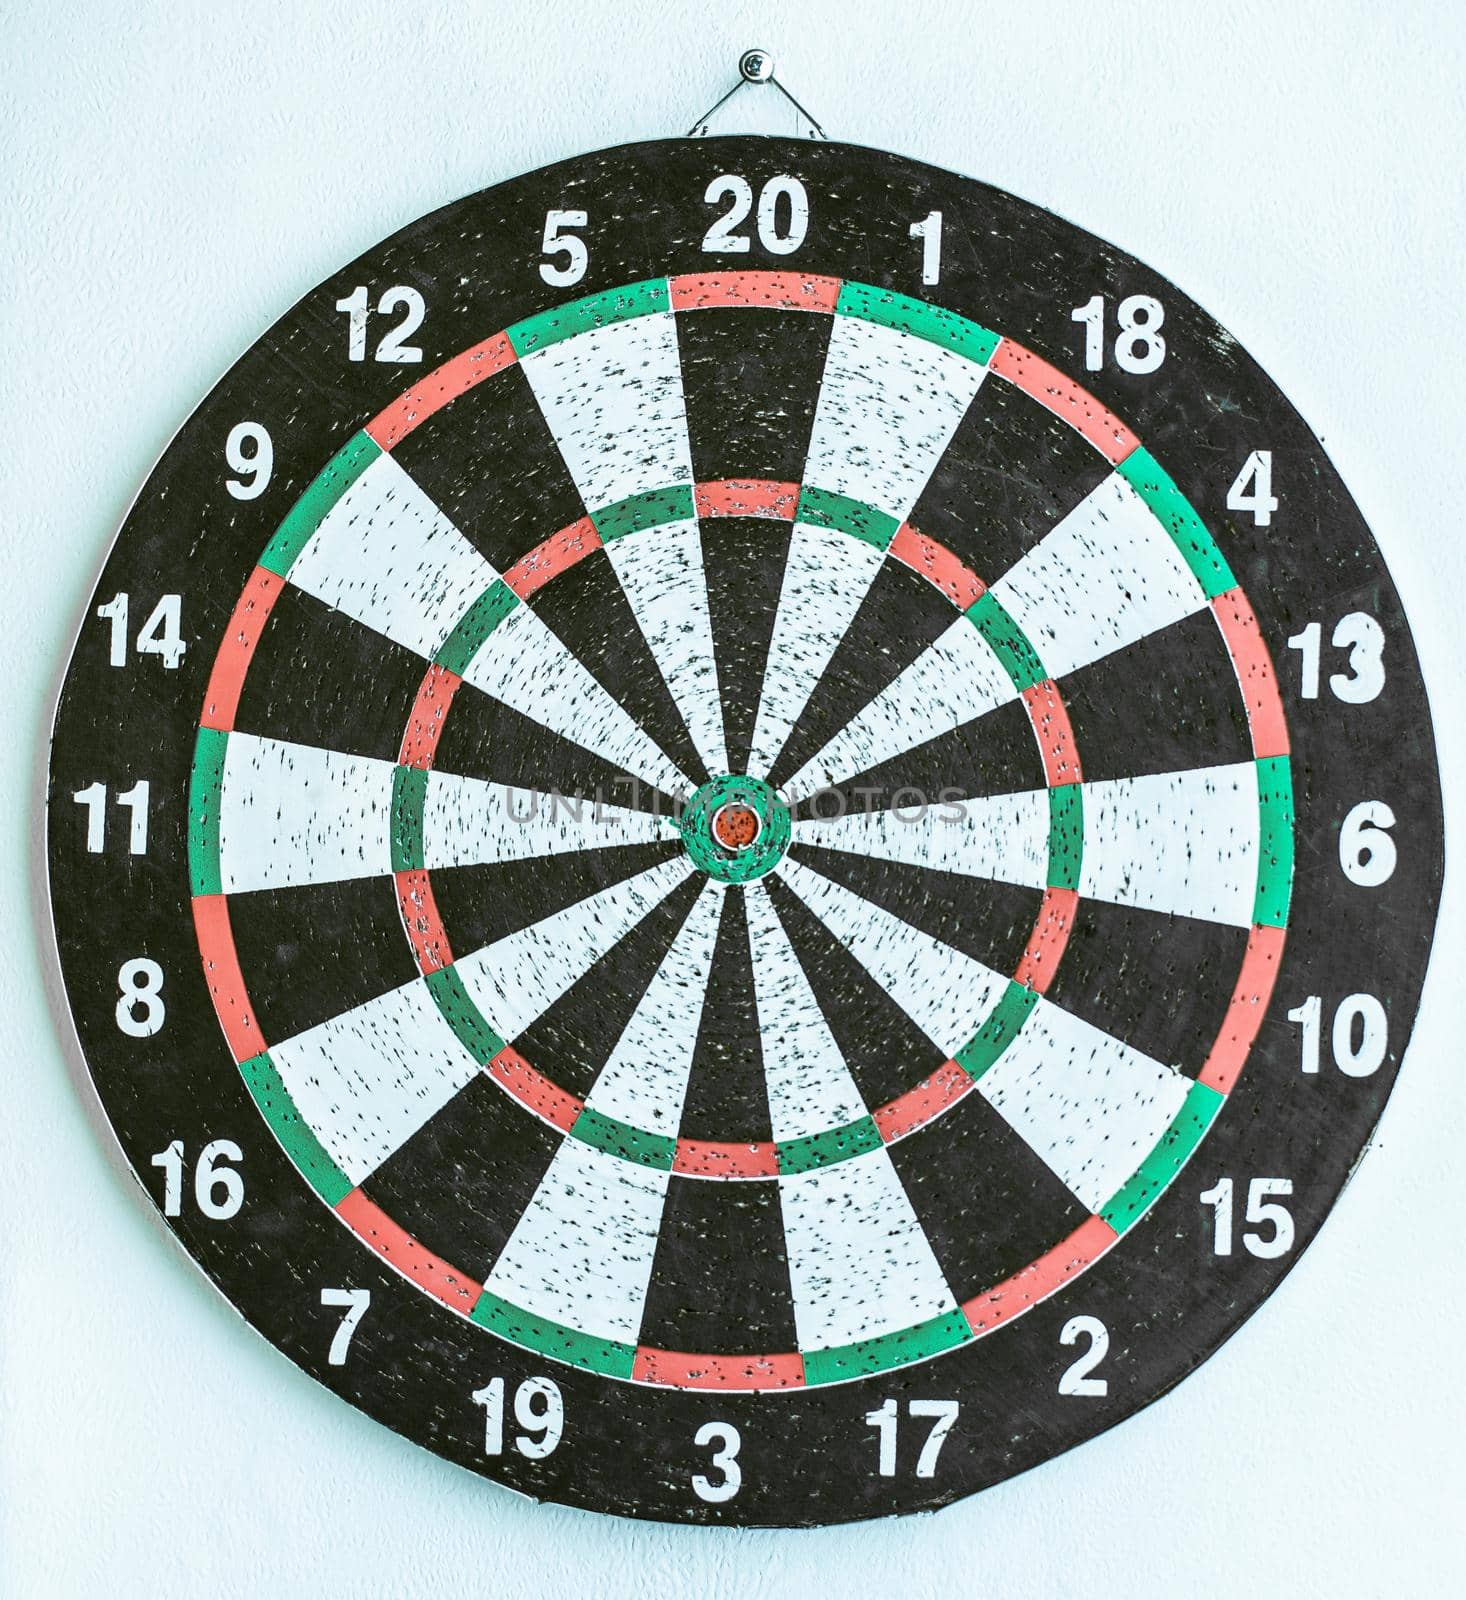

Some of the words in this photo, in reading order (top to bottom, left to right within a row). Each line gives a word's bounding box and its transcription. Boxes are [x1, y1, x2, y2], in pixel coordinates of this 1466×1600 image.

[539, 210, 588, 287] 5
[702, 174, 808, 254] 20
[910, 211, 942, 285] 1
[336, 286, 425, 362] 12
[1072, 295, 1165, 374] 18
[226, 422, 273, 500] 9
[1227, 451, 1278, 526] 4
[98, 593, 186, 668] 14
[1288, 612, 1385, 703] 13
[74, 780, 149, 854] 11
[1340, 801, 1396, 886] 6
[116, 958, 165, 1037] 8
[1288, 994, 1387, 1077] 10
[151, 1140, 244, 1220] 16
[1200, 1178, 1294, 1259] 15
[321, 1289, 370, 1365] 7
[1059, 1316, 1109, 1396] 2
[472, 1377, 563, 1458] 19
[866, 1399, 959, 1477] 17
[692, 1422, 741, 1502] 3
